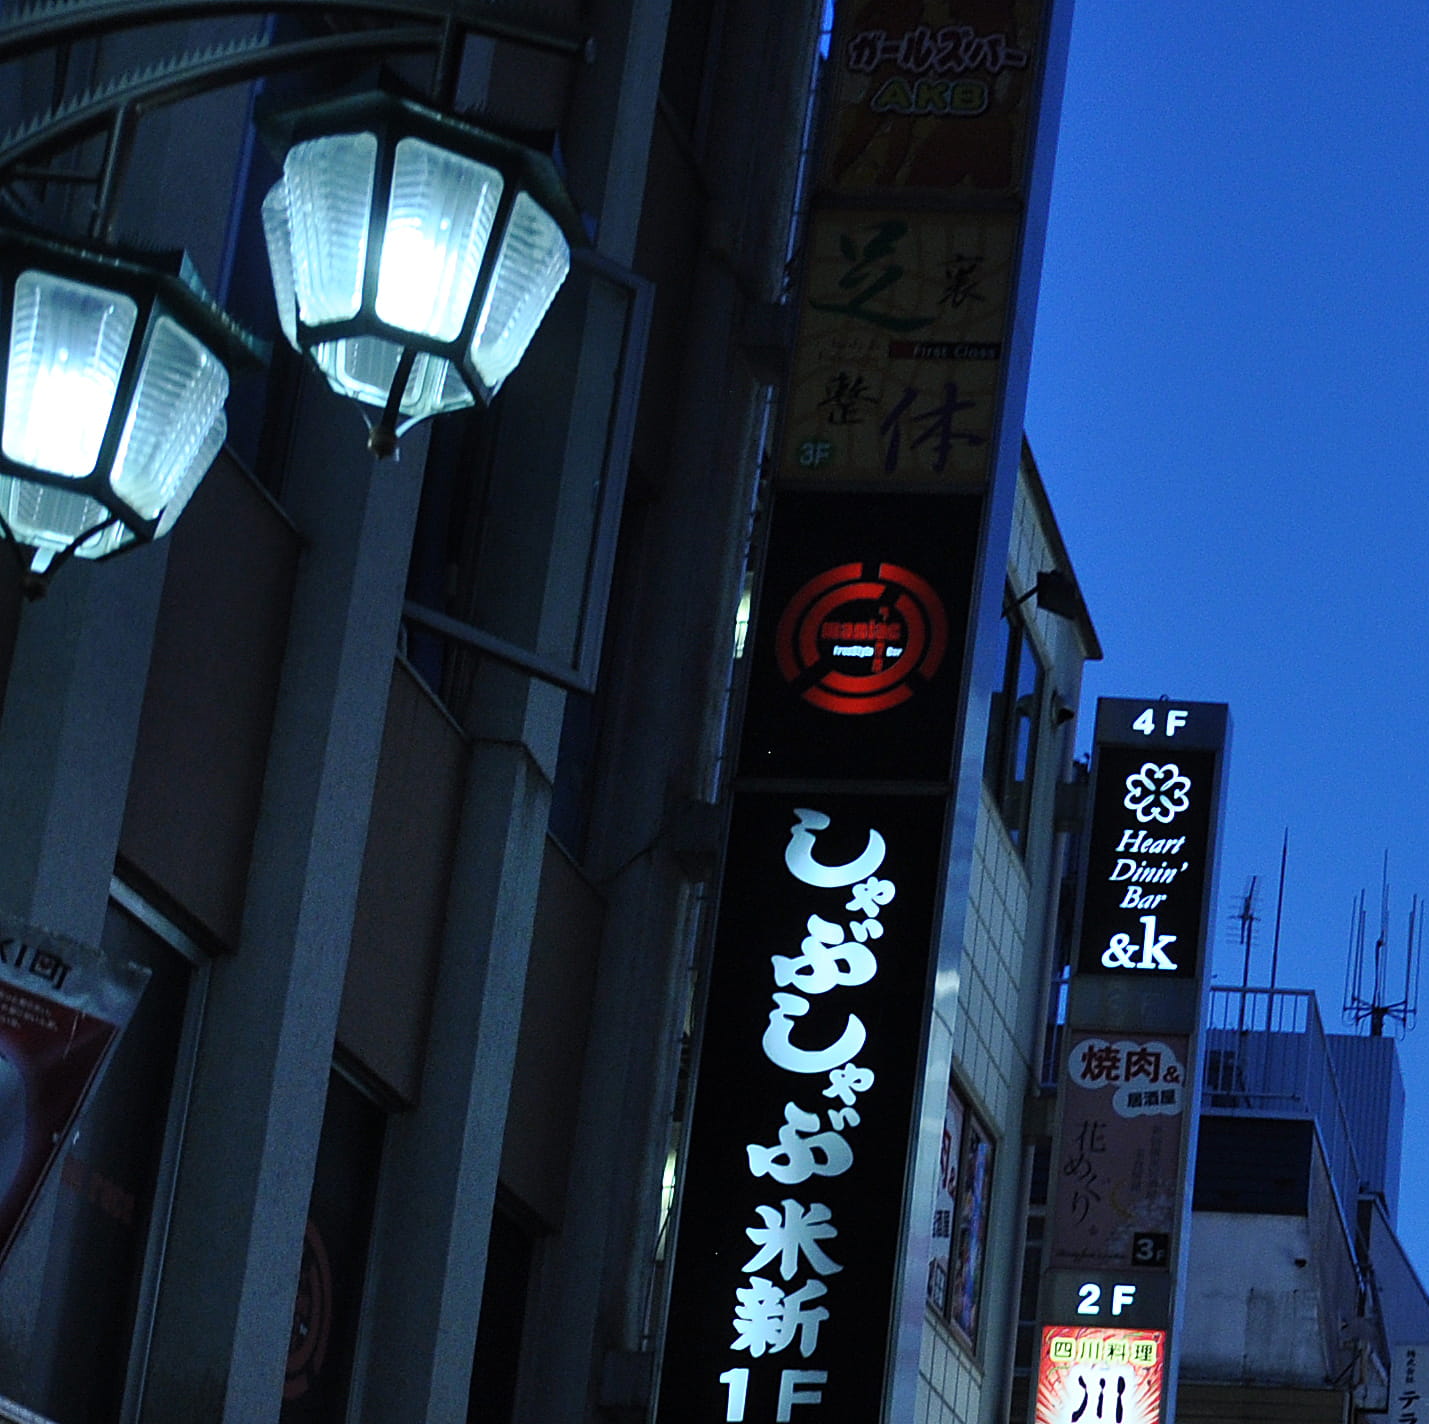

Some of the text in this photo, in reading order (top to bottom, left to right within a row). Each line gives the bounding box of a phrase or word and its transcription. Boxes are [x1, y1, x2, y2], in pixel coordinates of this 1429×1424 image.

[848, 27, 1028, 73] ガールズバー
[871, 80, 988, 116] AKB
[1132, 708, 1189, 737] 4F
[1115, 829, 1187, 855] Heart
[1109, 858, 1189, 884] Dinin'
[1119, 885, 1168, 910] Bar
[1101, 915, 1178, 971] &k
[1077, 1283, 1137, 1315] 2F
[719, 1368, 829, 1424] 1F
